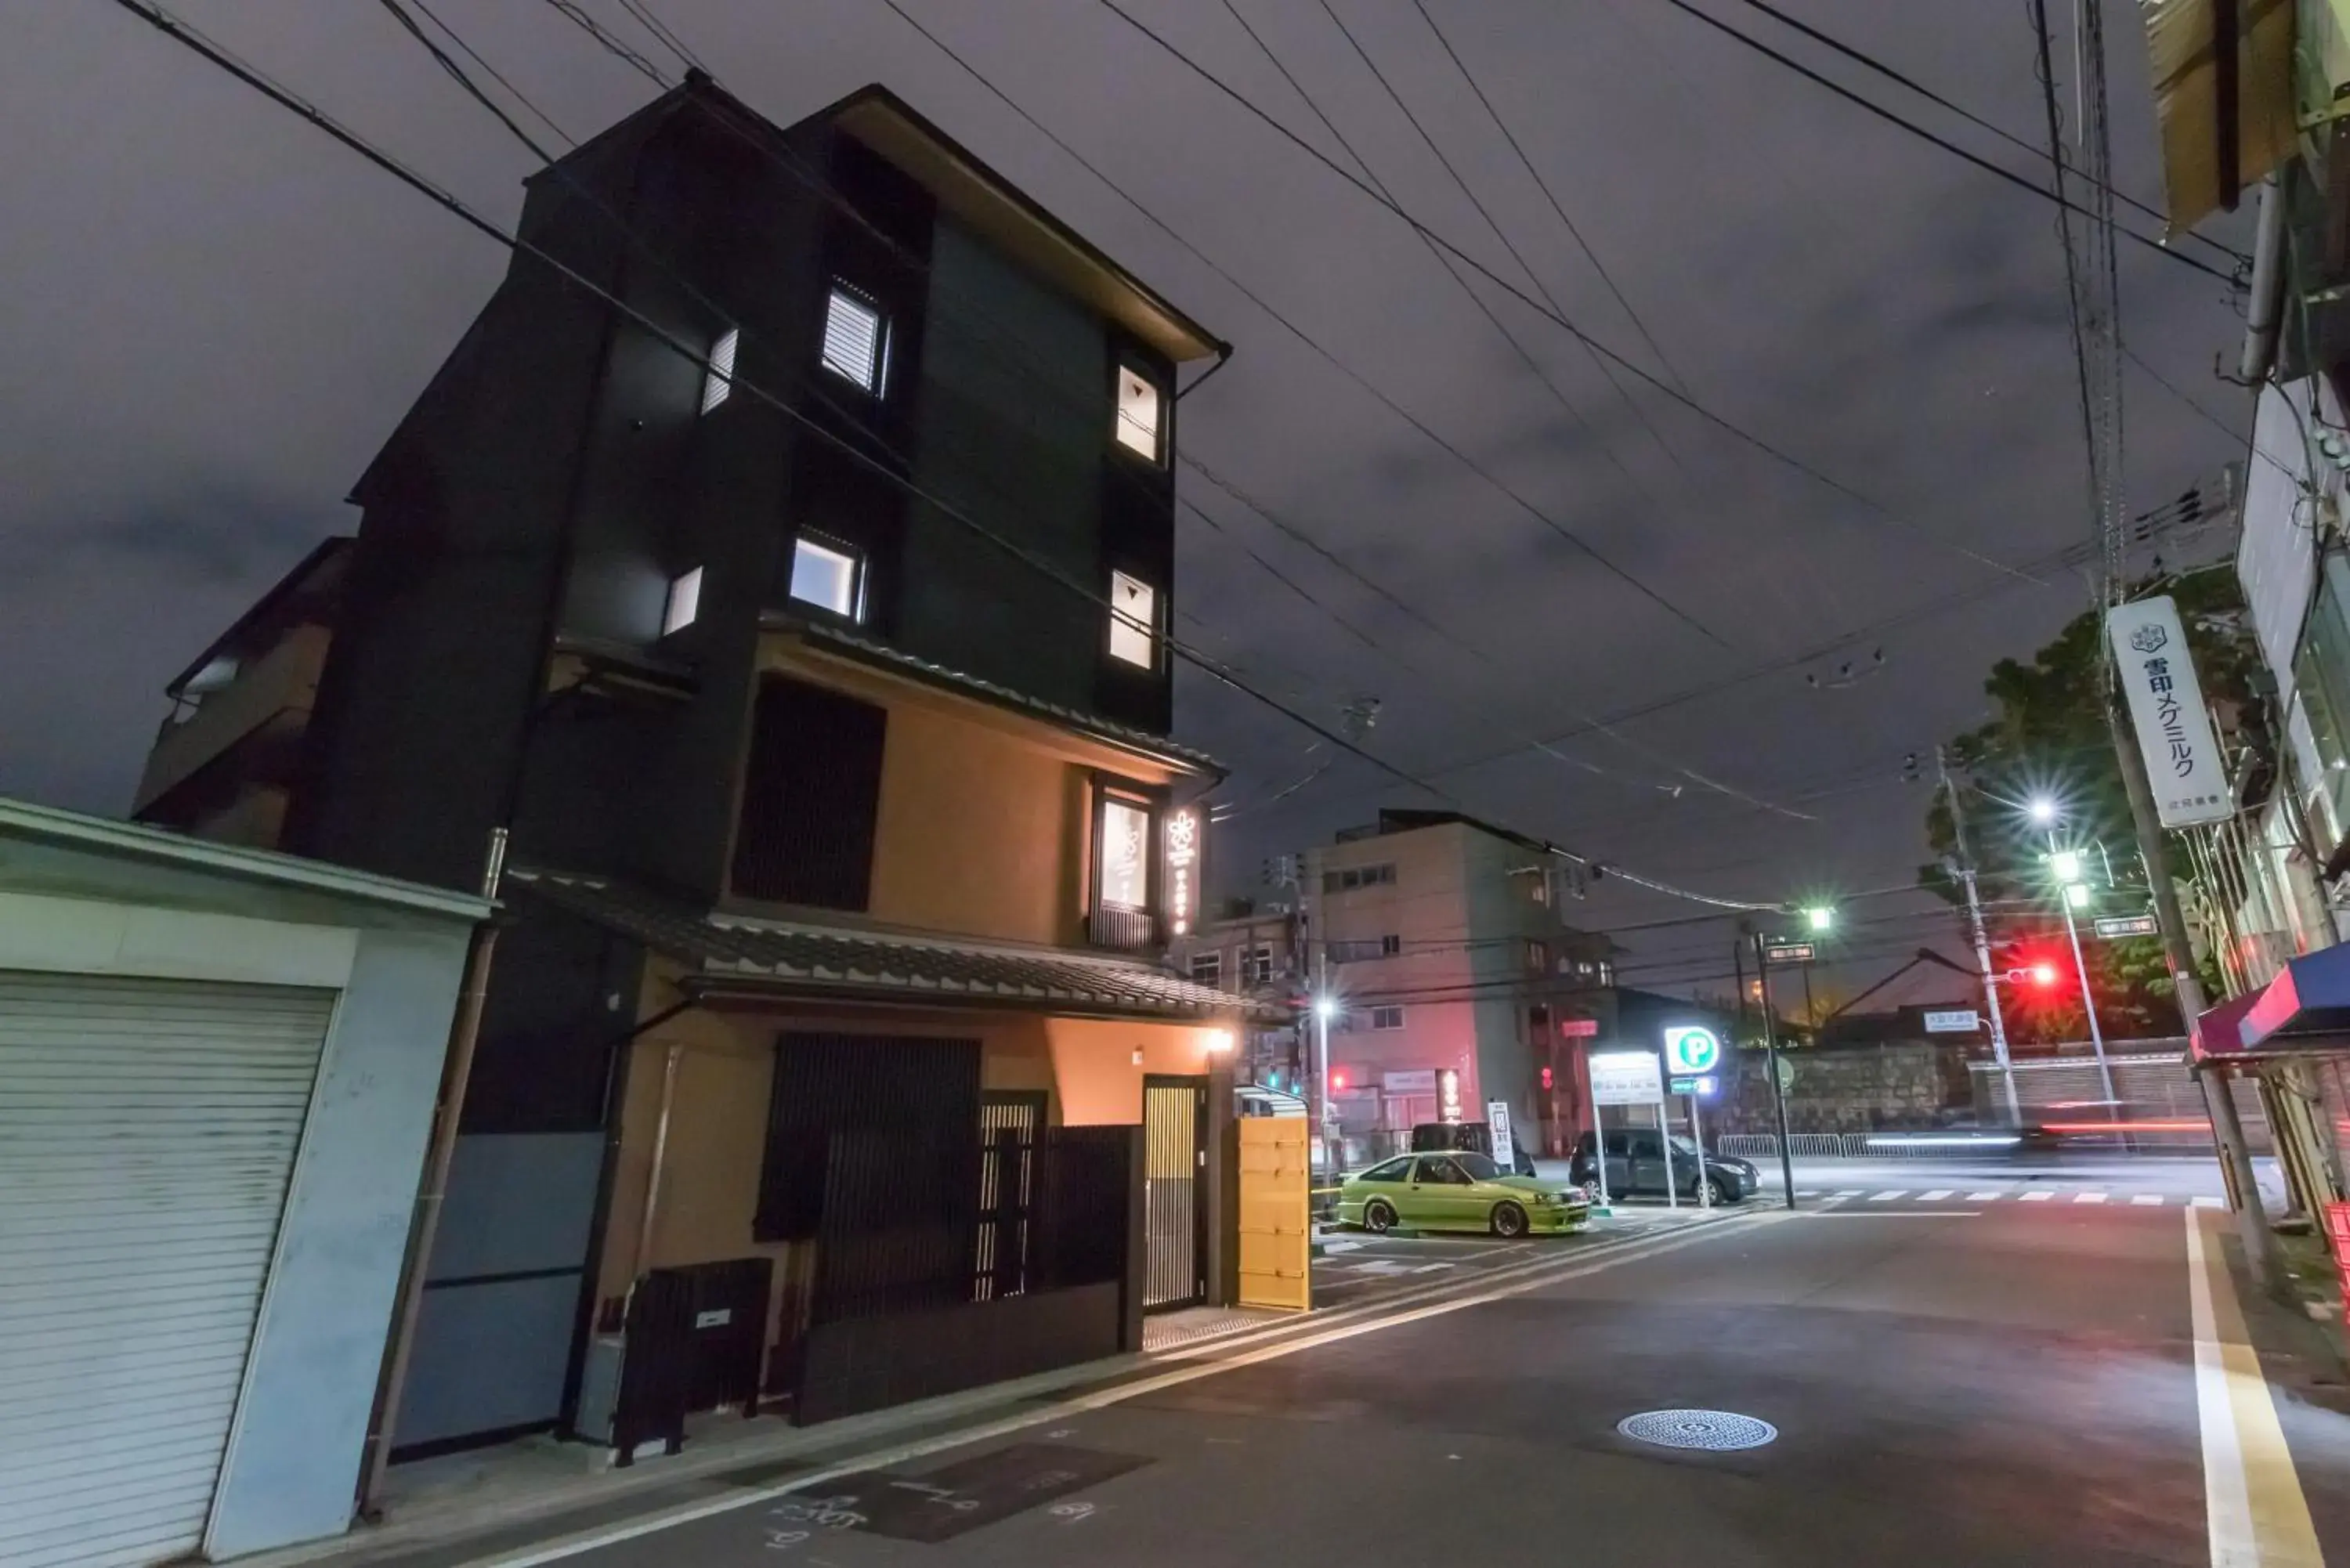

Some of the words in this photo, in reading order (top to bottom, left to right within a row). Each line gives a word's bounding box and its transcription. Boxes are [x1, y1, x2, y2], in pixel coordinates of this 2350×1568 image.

[2143, 657, 2193, 778] 雪印メグミルク
[1688, 1037, 1708, 1064] P
